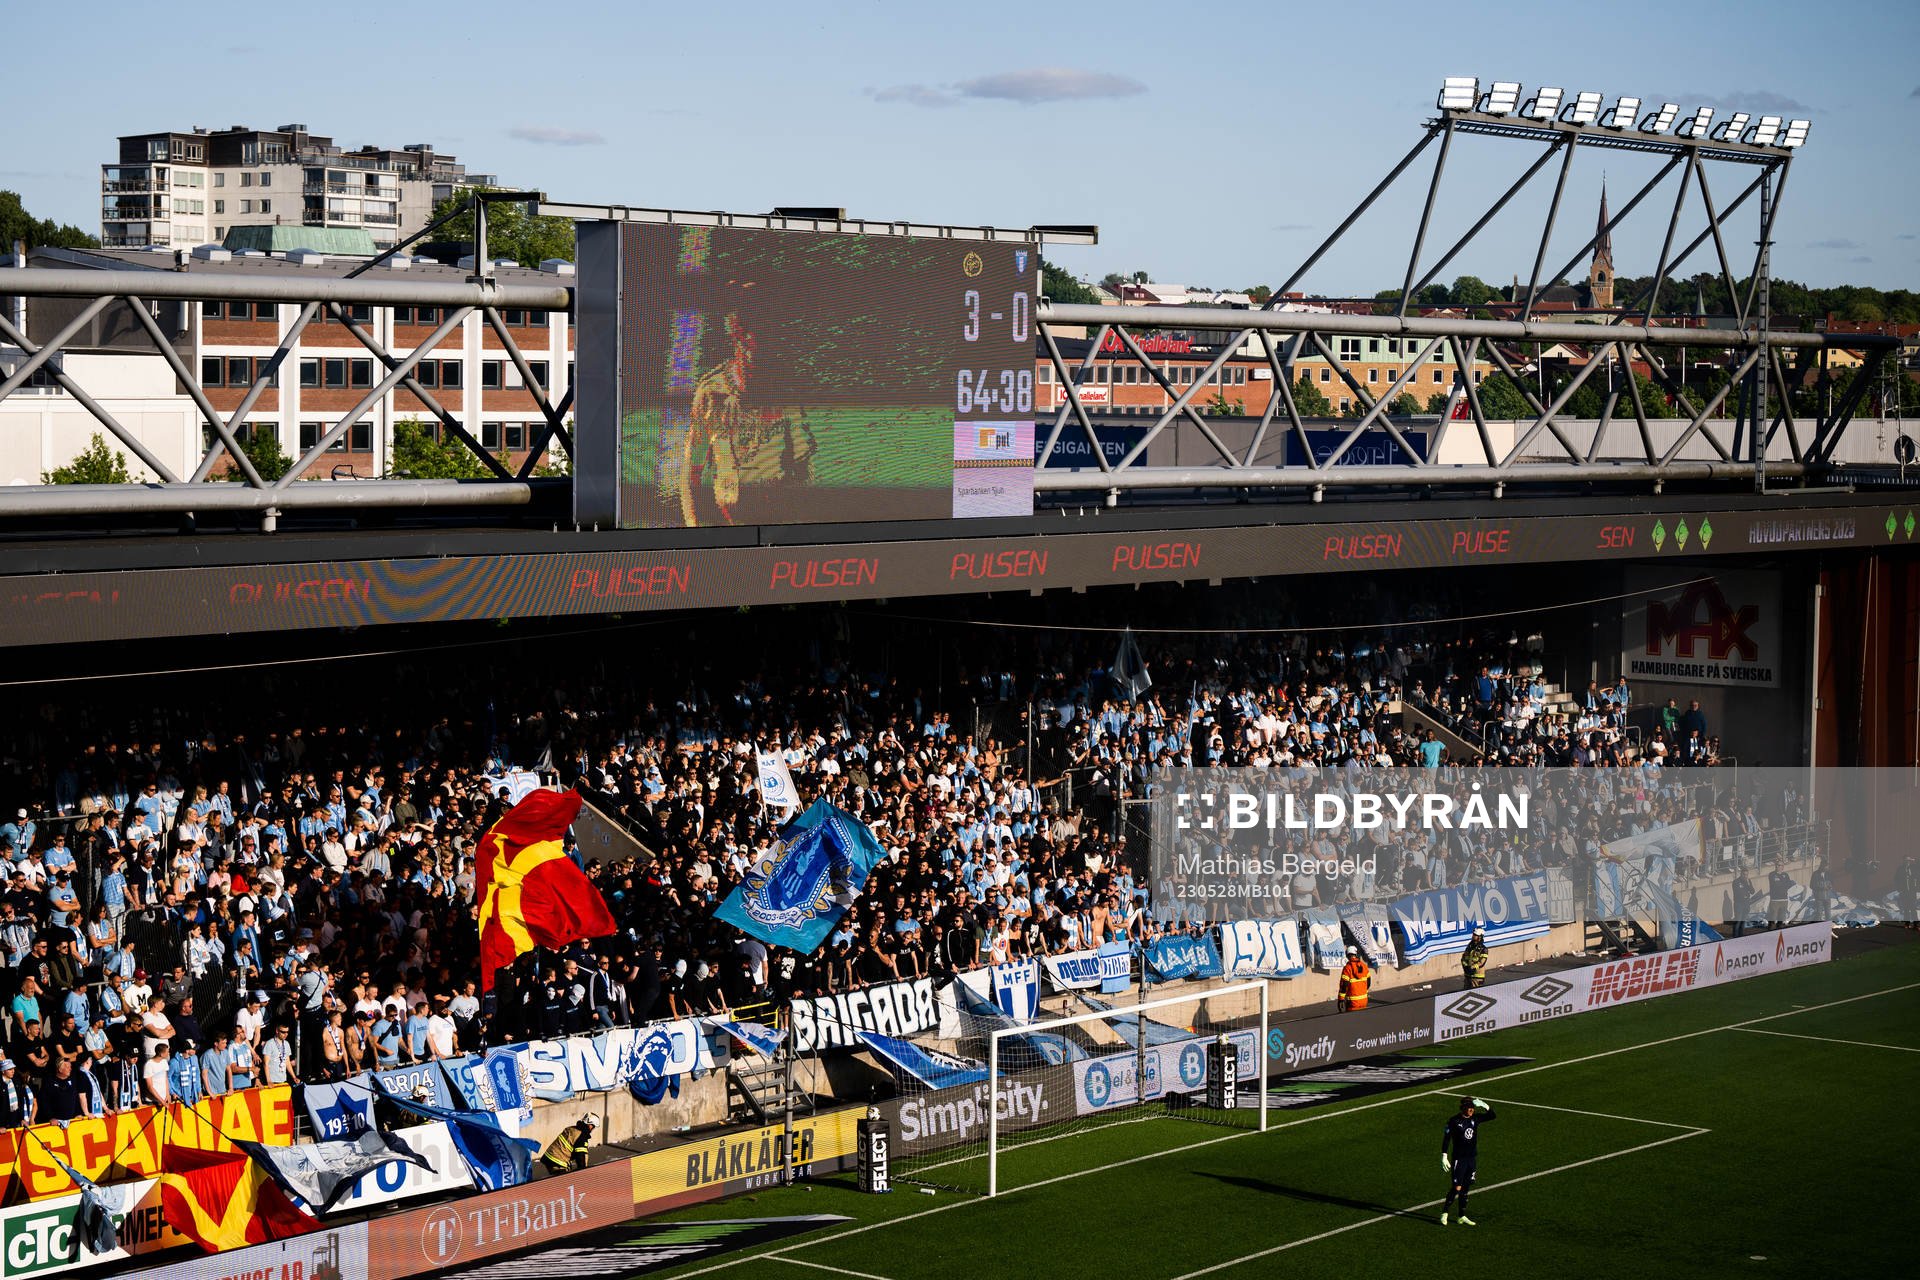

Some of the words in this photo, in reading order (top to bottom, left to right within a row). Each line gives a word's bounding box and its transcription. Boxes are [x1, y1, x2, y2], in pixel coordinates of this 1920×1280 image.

[964, 290, 980, 342] 3
[1012, 291, 1029, 343] 0
[1078, 390, 1107, 401] nalleland
[1035, 440, 1126, 456] EGIGATEN
[1324, 533, 1402, 561] PULSEN
[1451, 529, 1510, 555] PULSE
[1596, 525, 1636, 549] SEN
[950, 549, 1049, 580] PULSEN
[1112, 542, 1202, 573] PULSEN
[568, 564, 691, 599] PULSEN
[769, 557, 880, 590] PULSEN
[1631, 660, 1705, 679] HAMBURGARE
[1706, 663, 1722, 679] PÅ
[1722, 665, 1773, 682] SVENSKA
[1395, 881, 1510, 946] MALMÖ
[1512, 876, 1547, 919] FF
[1222, 920, 1302, 972] 1910
[1787, 939, 1827, 957] PAROY
[1727, 952, 1765, 970] PAROY
[1003, 969, 1031, 986] MFF
[1587, 949, 1698, 1006] MOBILEN
[791, 977, 938, 1052] BRIGADA
[1519, 1003, 1573, 1022] UMBRO
[1379, 1032, 1397, 1046] with
[1399, 1029, 1411, 1042] the
[1413, 1026, 1430, 1039] flow
[1441, 1019, 1496, 1039] UMBRO
[1285, 1035, 1337, 1068] Syncify
[1223, 1056, 1236, 1110] SELECT
[326, 1117, 342, 1136] 19
[352, 1112, 365, 1130] 10
[25, 1086, 293, 1194] SCANIAE
[686, 1127, 815, 1188] BLÅKLÄDER
[871, 1132, 888, 1192] SELECT
[745, 1164, 812, 1189] WORKEAR
